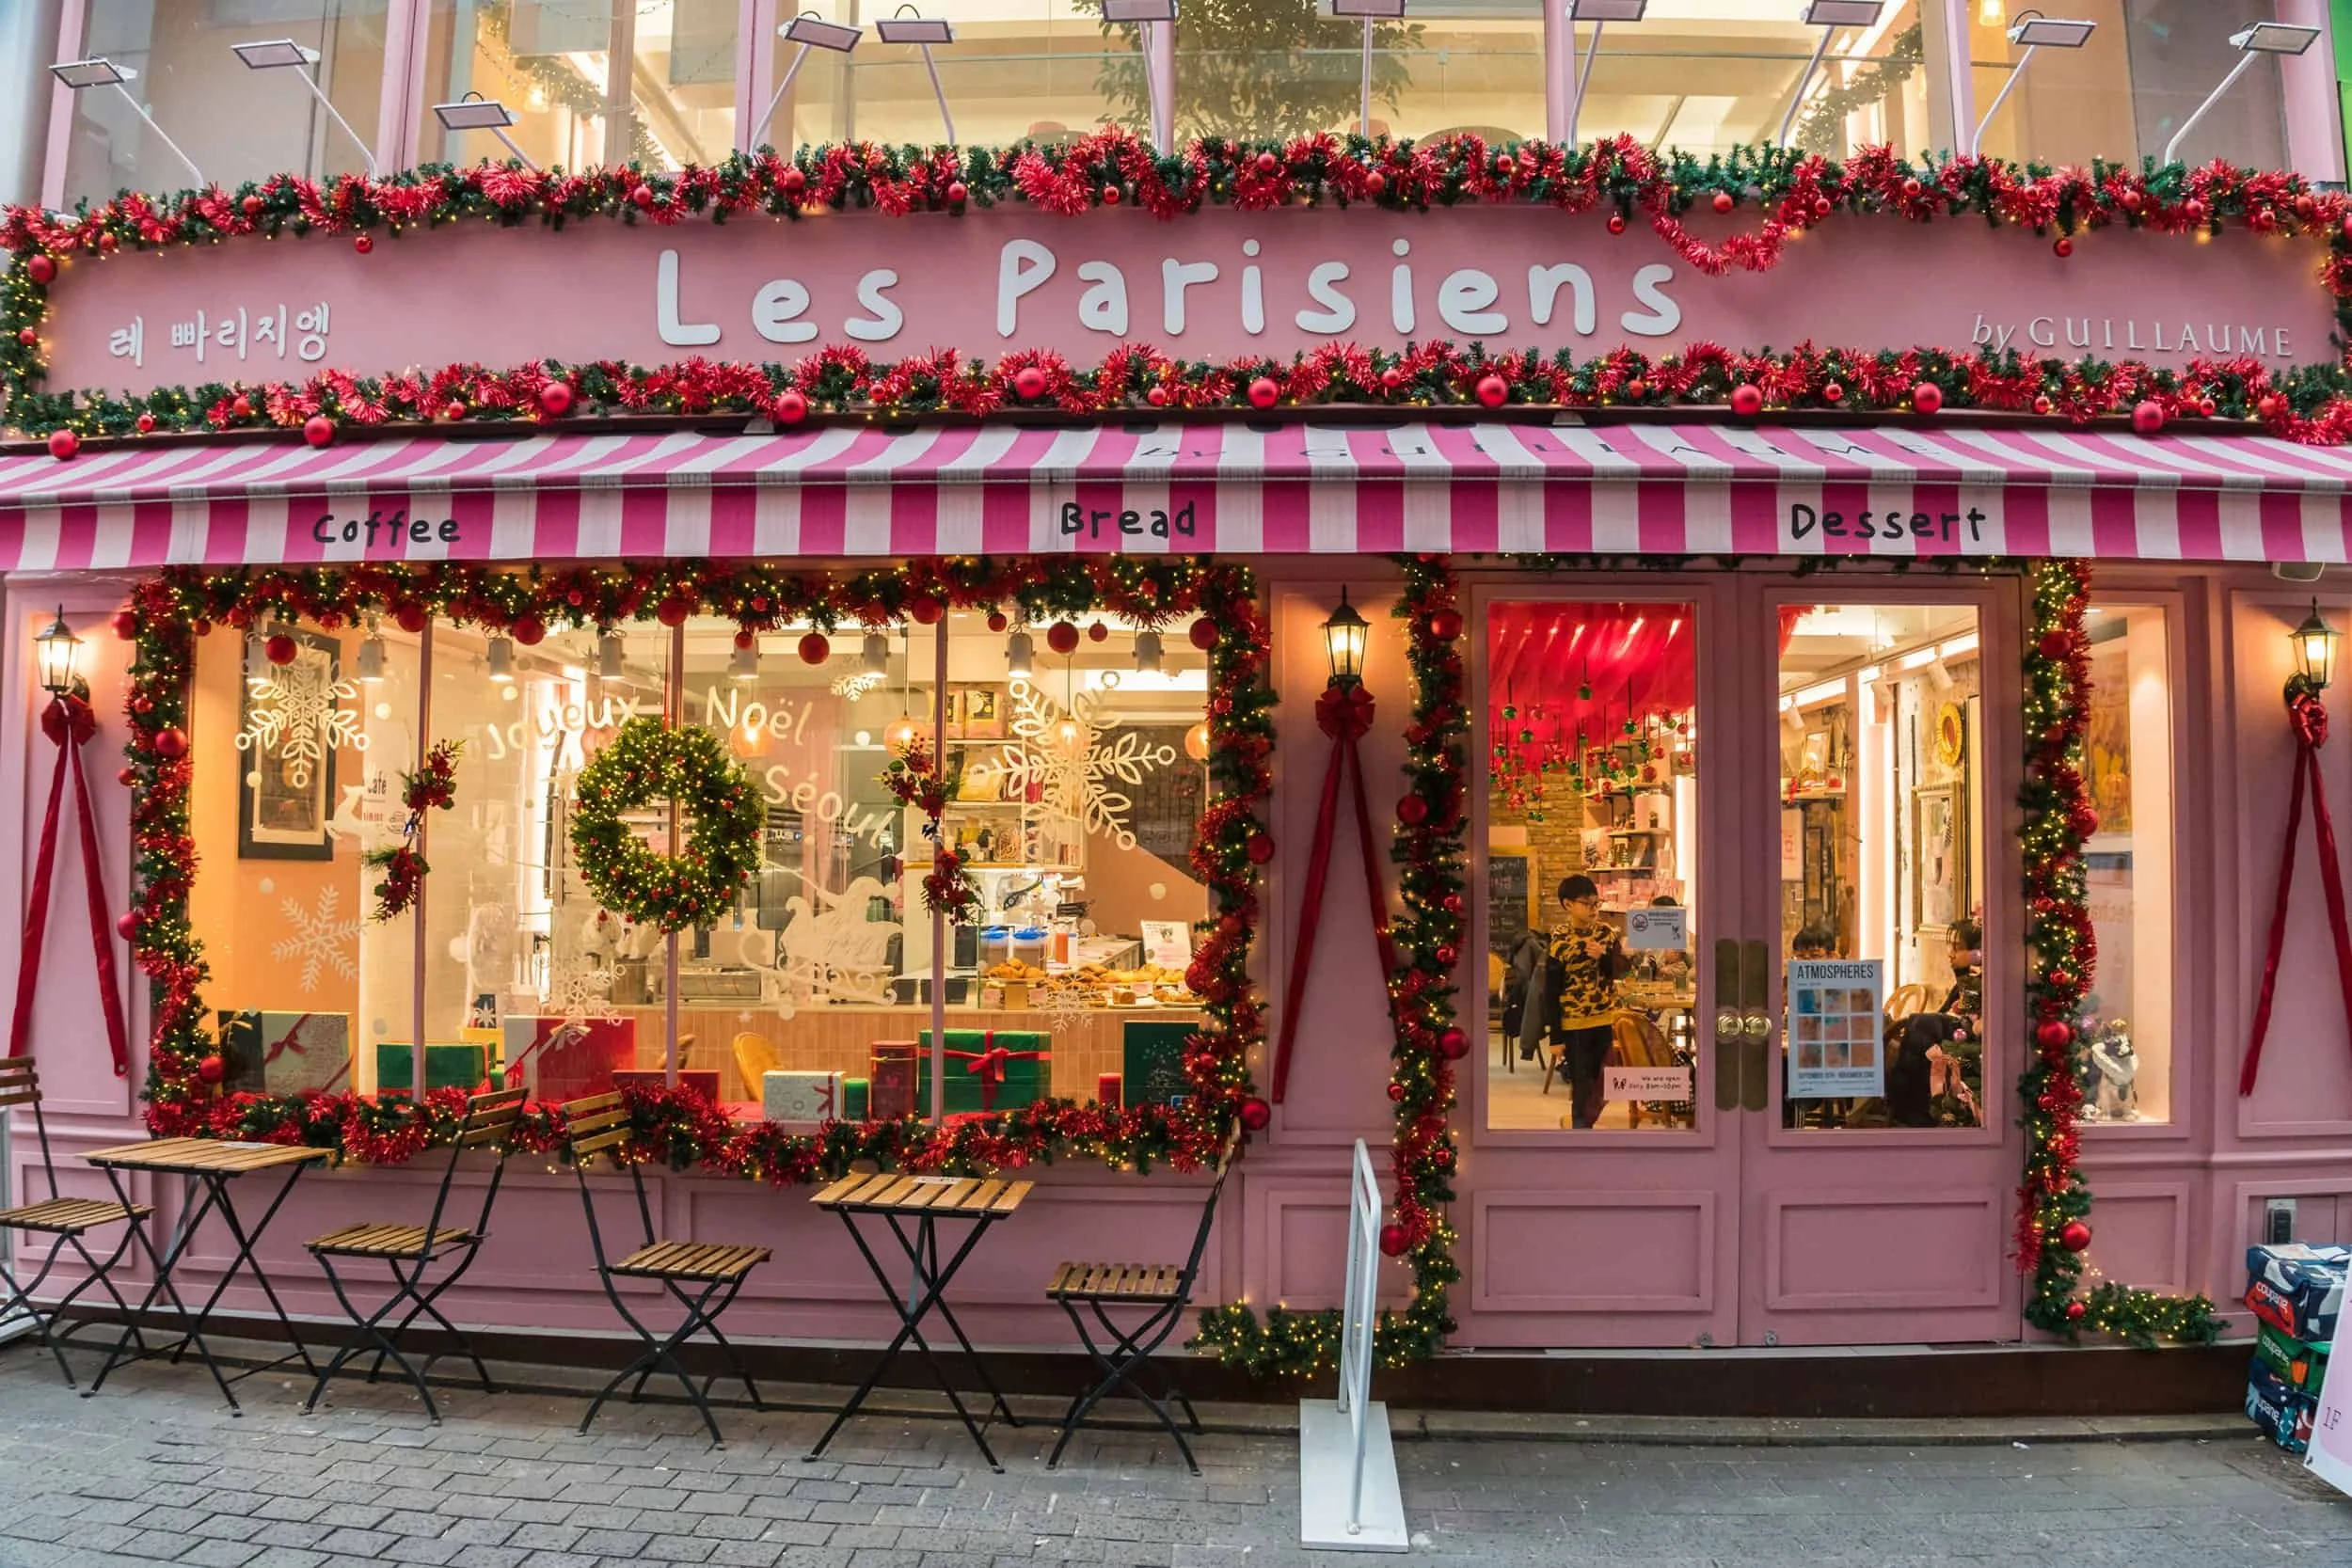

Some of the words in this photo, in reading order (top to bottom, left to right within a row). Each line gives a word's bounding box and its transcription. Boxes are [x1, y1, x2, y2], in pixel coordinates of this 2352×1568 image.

[657, 248, 904, 344] Les
[996, 238, 1681, 338] Parisiens
[109, 315, 143, 368] 레
[1971, 315, 2015, 355] by
[2027, 316, 2294, 357] GUILLAUME
[312, 512, 461, 547] Coffee
[1060, 500, 1196, 538] Bread
[1790, 503, 1987, 543] Dessert
[486, 694, 642, 760] Joyeux
[705, 686, 815, 748] Noël
[763, 764, 897, 850] Séoul
[1797, 964, 1874, 979] ATMOSPHERES
